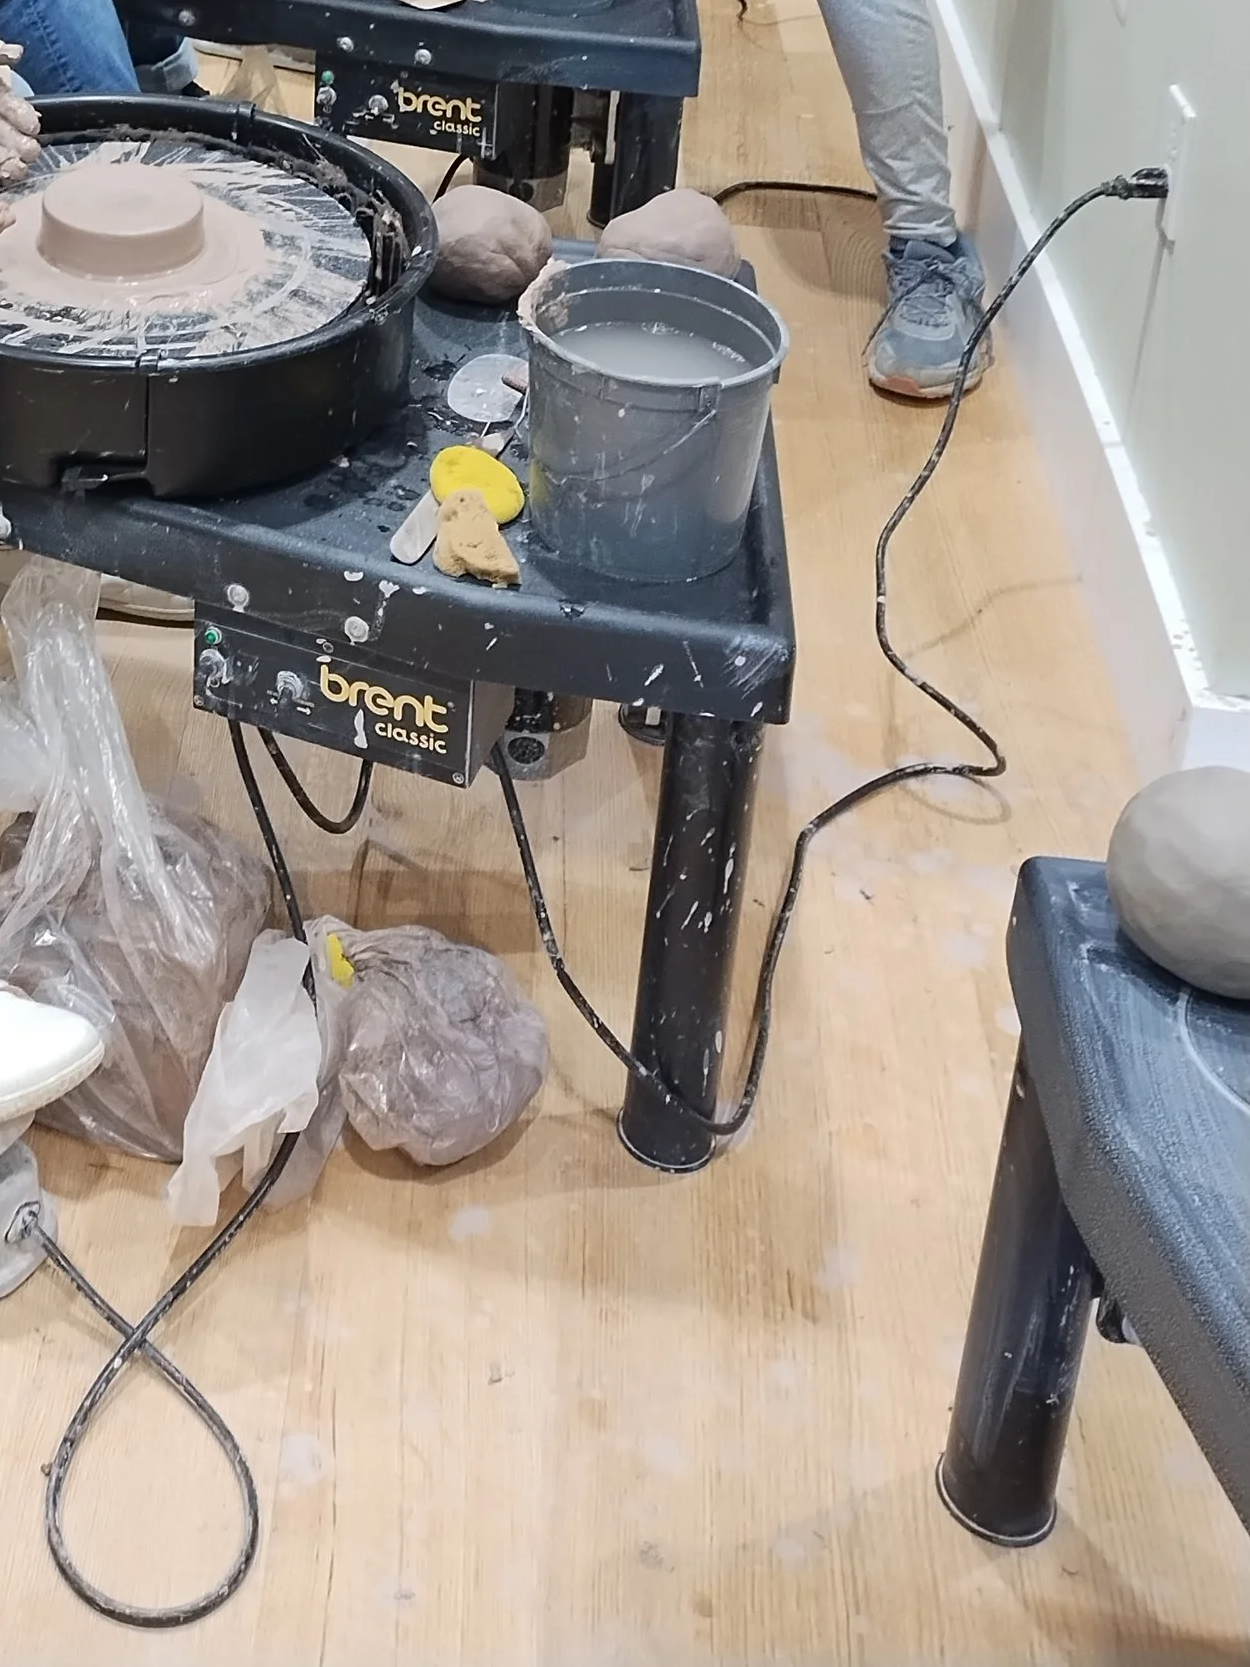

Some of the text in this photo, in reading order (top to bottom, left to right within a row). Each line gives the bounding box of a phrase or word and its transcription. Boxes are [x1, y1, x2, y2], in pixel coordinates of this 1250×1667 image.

[398, 87, 483, 122] brent
[433, 119, 481, 137] classic
[320, 664, 449, 733] brent
[375, 721, 447, 754] classic
